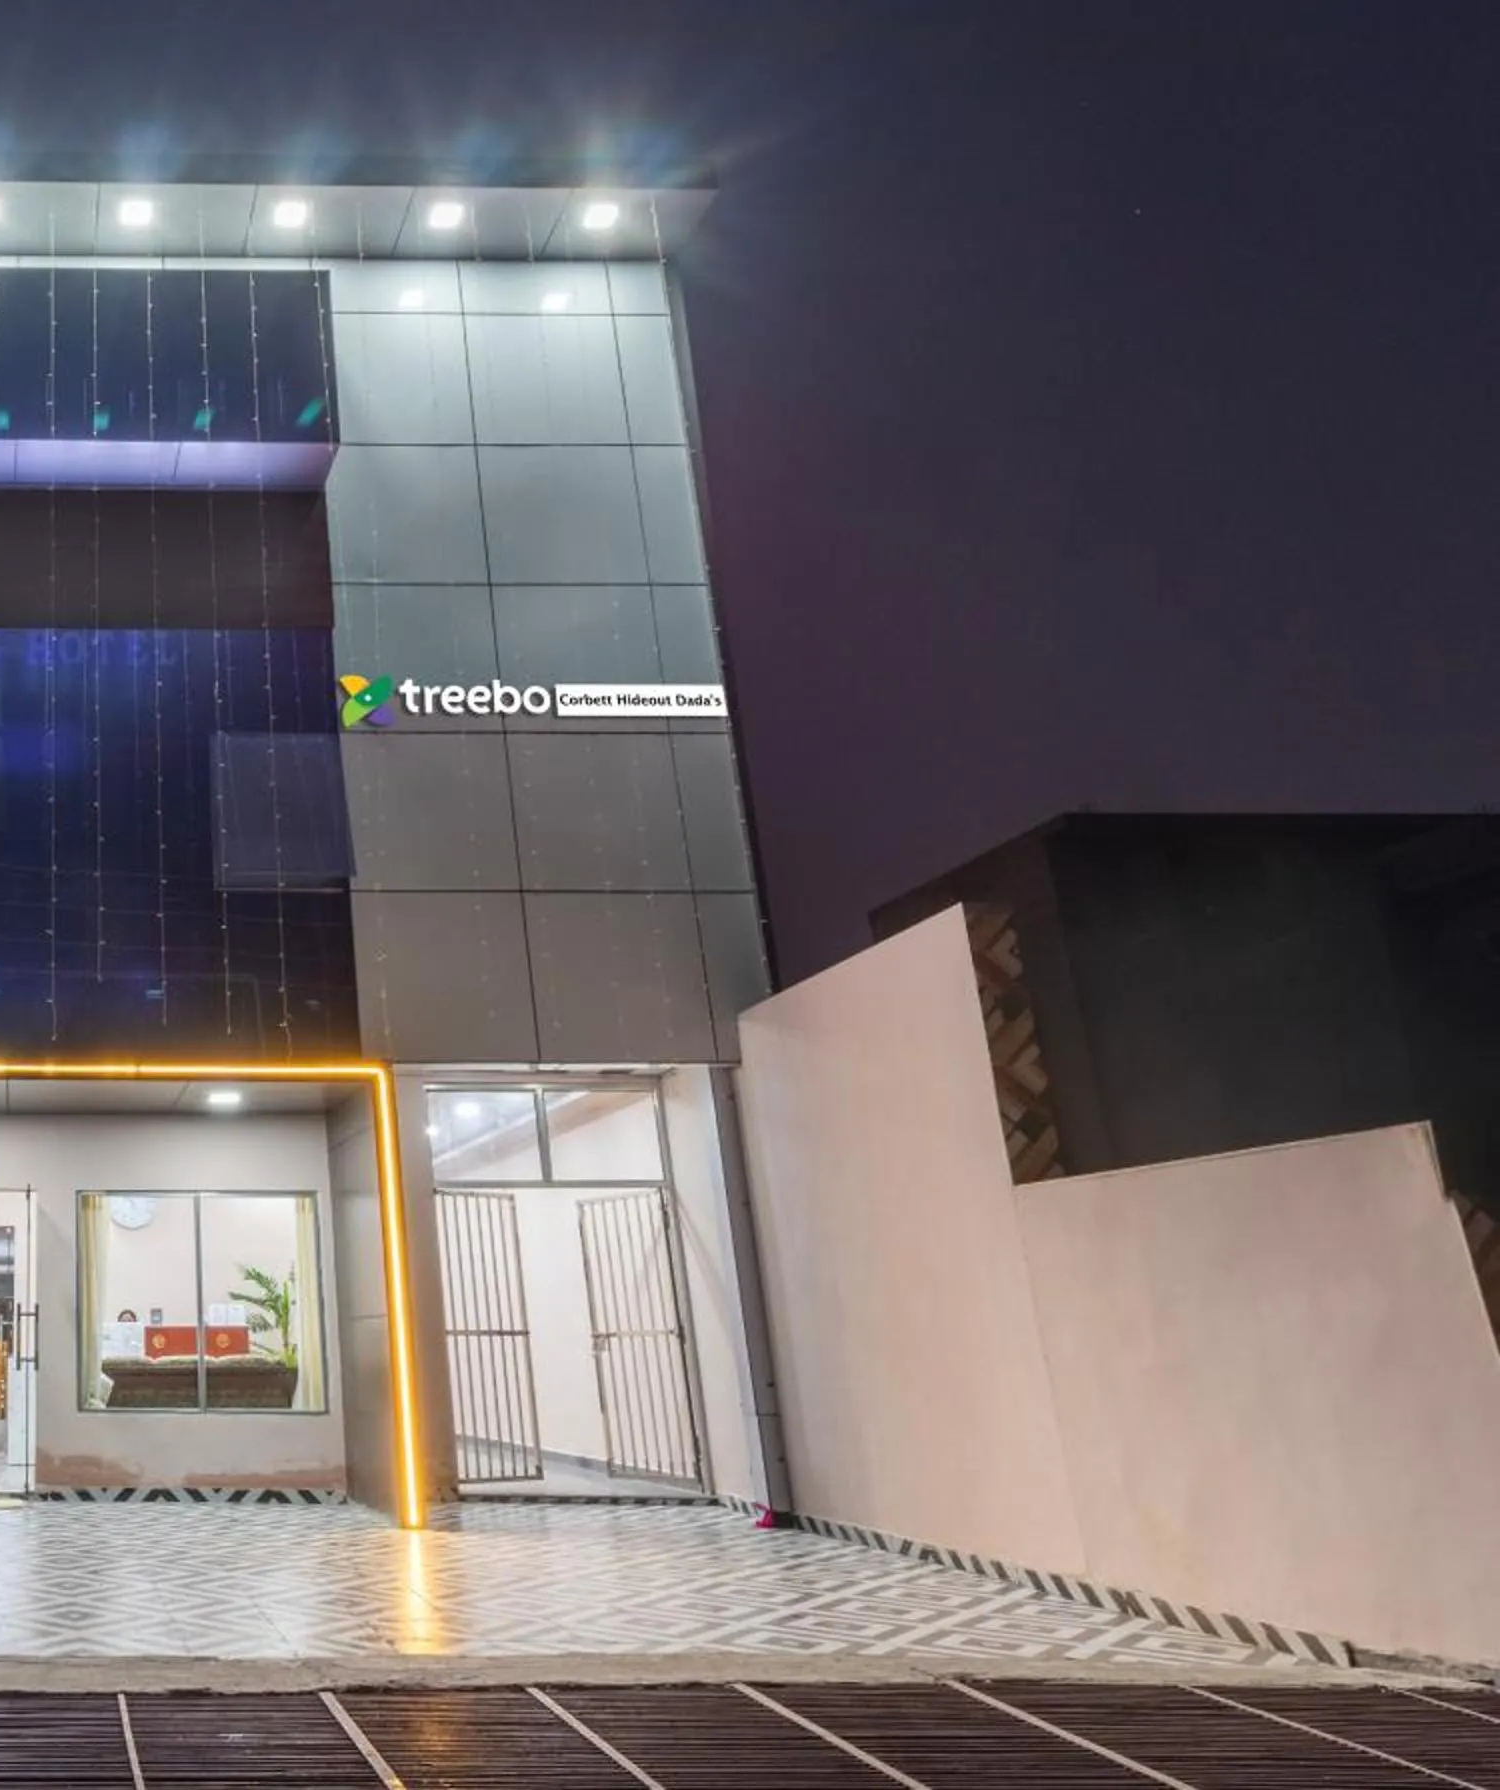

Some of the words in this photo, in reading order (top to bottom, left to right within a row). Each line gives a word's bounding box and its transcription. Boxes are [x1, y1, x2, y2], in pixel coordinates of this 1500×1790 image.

[399, 678, 551, 716] treebo
[559, 693, 612, 707] Corbett
[616, 693, 672, 707] Hideout
[675, 693, 723, 707] Dada's
